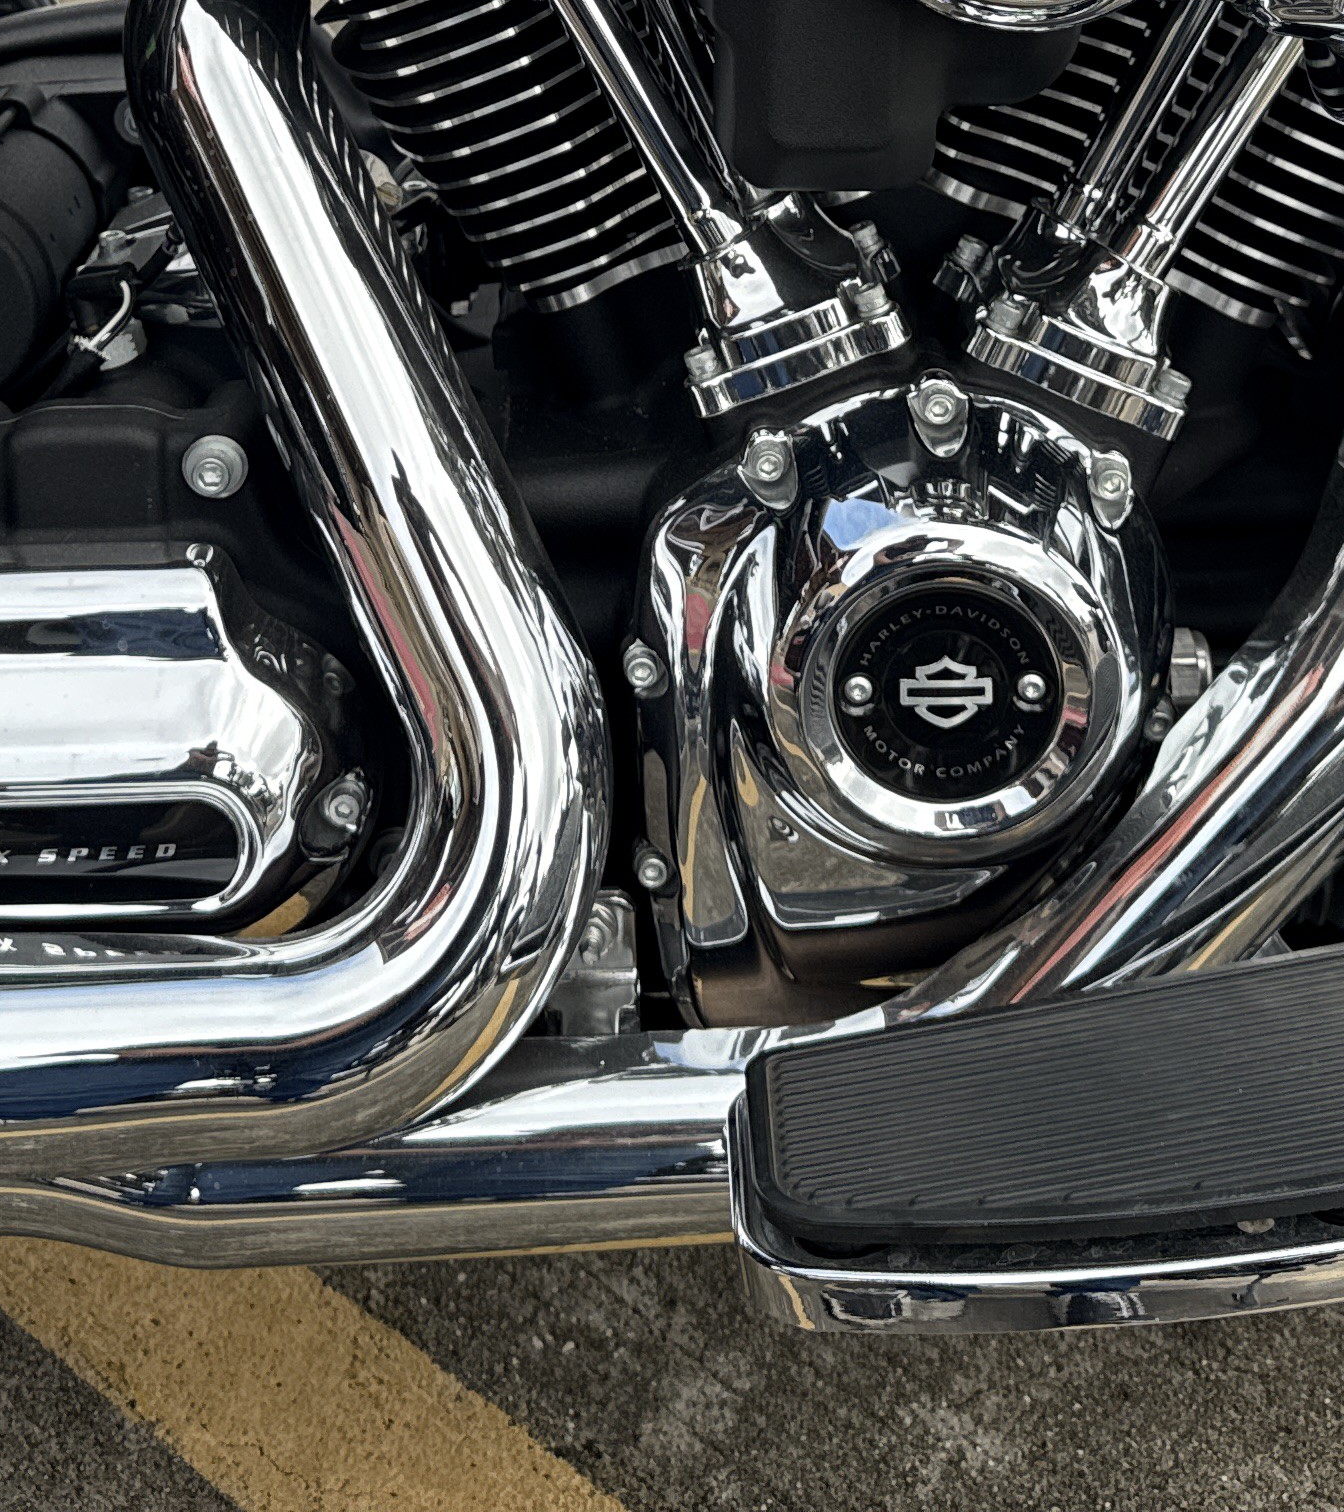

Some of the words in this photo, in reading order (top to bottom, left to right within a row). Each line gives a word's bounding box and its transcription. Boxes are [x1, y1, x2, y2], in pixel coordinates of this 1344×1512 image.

[859, 605, 1031, 666] HARLEY-DAVIDSON
[863, 724, 926, 776] MOTOR
[936, 723, 1025, 779] COMPANY
[36, 843, 177, 865] SPEED
